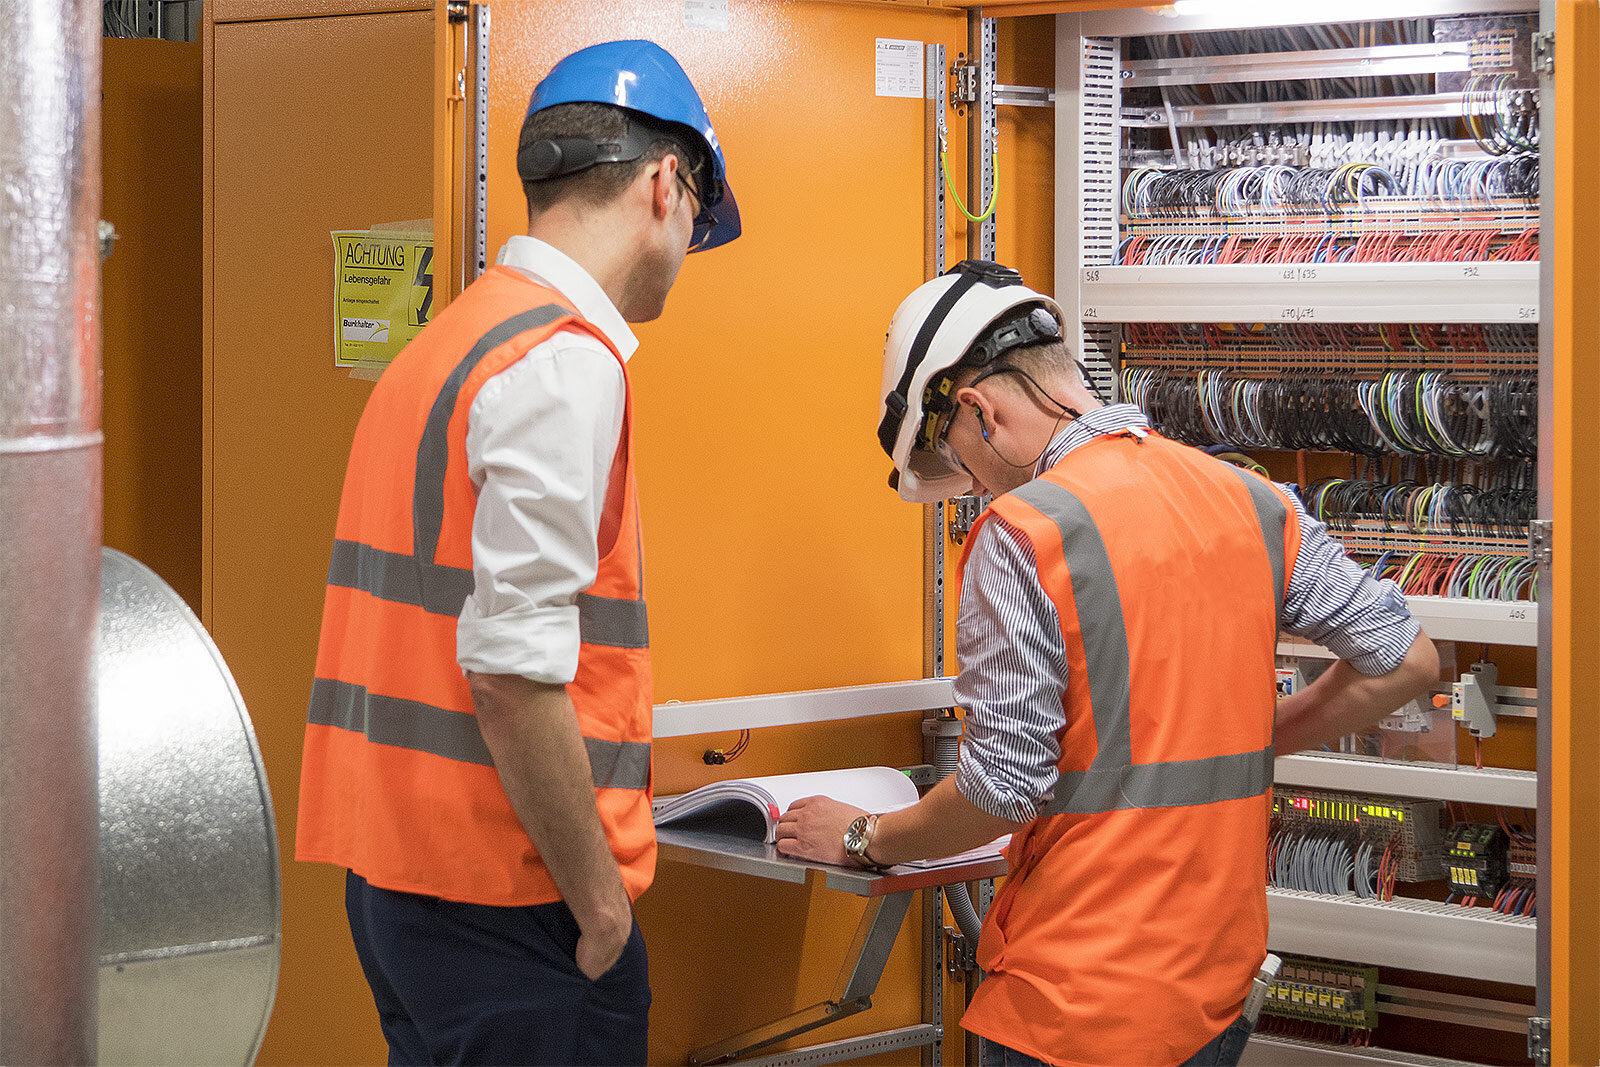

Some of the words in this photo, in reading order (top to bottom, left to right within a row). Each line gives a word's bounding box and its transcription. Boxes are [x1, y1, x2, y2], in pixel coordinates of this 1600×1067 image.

[345, 242, 404, 266] ACHTUNG
[344, 273, 392, 287] Lebensgefahr
[1086, 270, 1100, 281] 568
[1283, 269, 1295, 280] 631
[1302, 269, 1317, 279] 635
[1083, 307, 1098, 318] 421
[1518, 307, 1536, 319] 567
[343, 319, 375, 329] Burkhalter
[1509, 609, 1526, 620] 406
